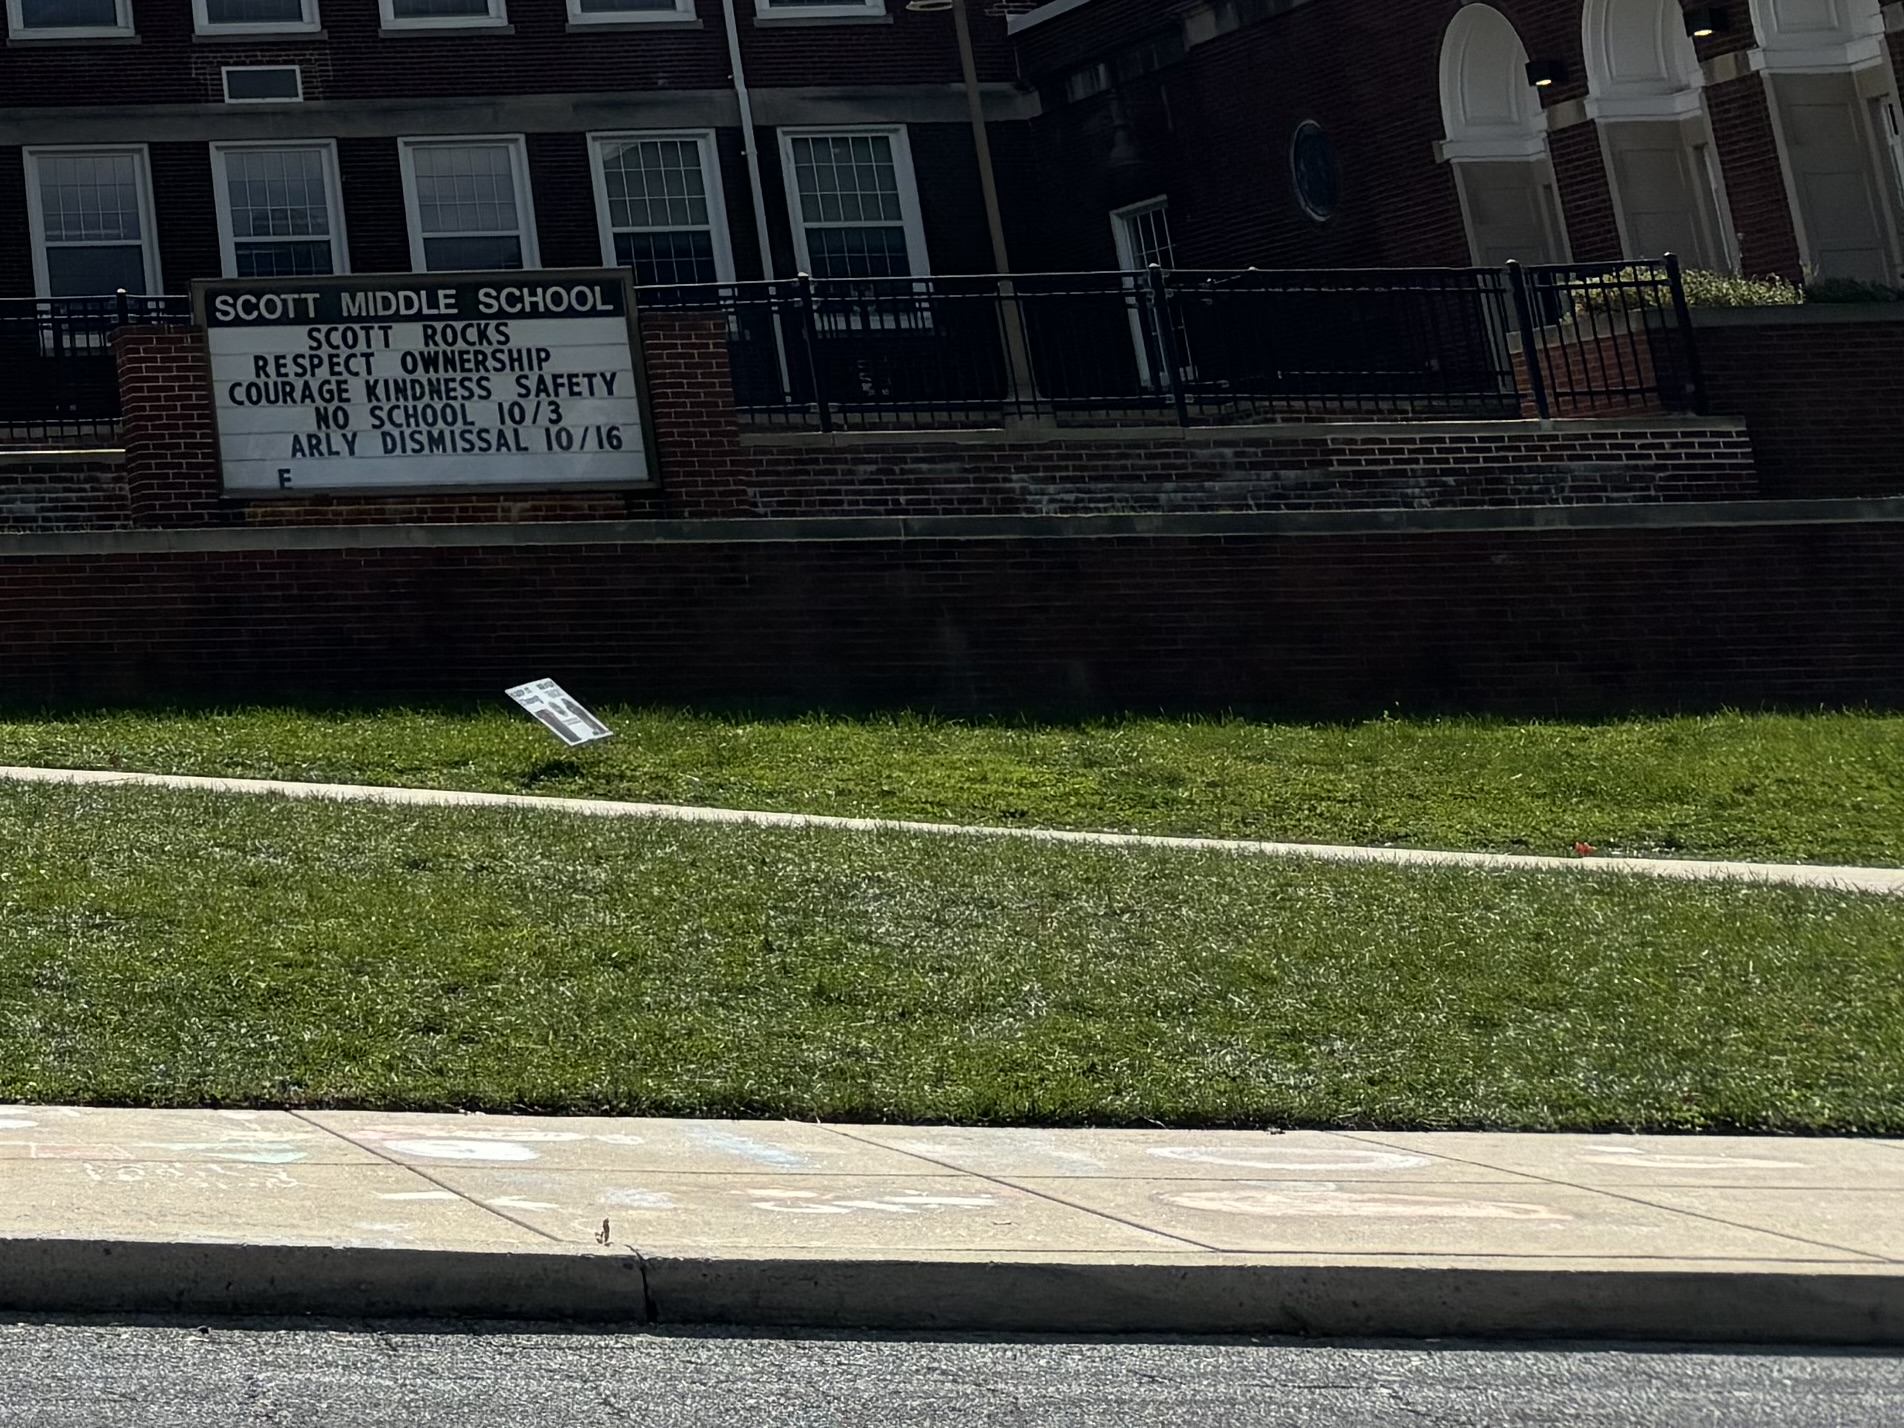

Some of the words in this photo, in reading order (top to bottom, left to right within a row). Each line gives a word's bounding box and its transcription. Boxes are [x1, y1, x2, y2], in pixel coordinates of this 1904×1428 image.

[215, 293, 320, 321] SCOTT
[340, 289, 459, 317] MIDDLE
[477, 285, 614, 314] SCHOOL
[307, 325, 393, 351] SCOTT
[422, 322, 511, 347] ROCKS
[253, 352, 375, 379] RESPECT
[400, 347, 551, 375] OWNERSHIP
[228, 379, 351, 406] COURAGE
[364, 375, 492, 403] KINDNESS
[515, 372, 617, 398] SAFETY
[314, 405, 350, 431] NO
[369, 402, 476, 429] SCHOOL
[497, 400, 563, 426] 10/3
[291, 431, 358, 458] ARLY
[380, 427, 529, 455] DISMISSAL
[544, 425, 623, 452] 10/16
[277, 468, 293, 490] E
